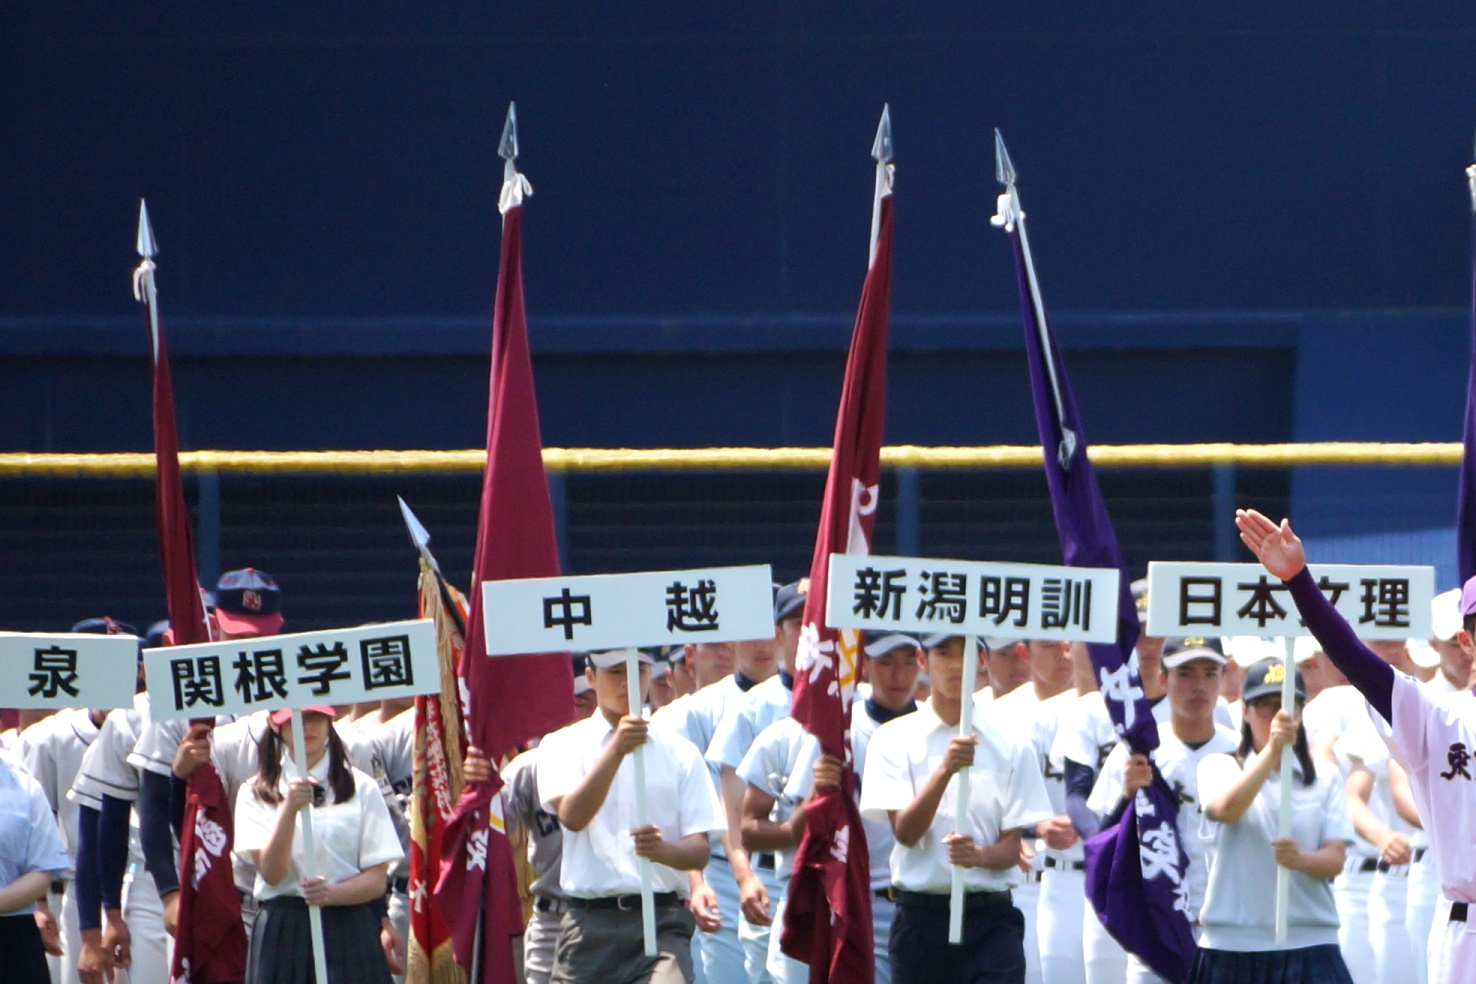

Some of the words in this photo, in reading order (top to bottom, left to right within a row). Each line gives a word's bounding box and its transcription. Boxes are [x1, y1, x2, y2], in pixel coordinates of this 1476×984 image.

[542, 579, 719, 640] 中越
[852, 566, 1092, 631] 新潟明訓
[28, 645, 80, 698] 泉
[170, 634, 414, 711] 関根学園
